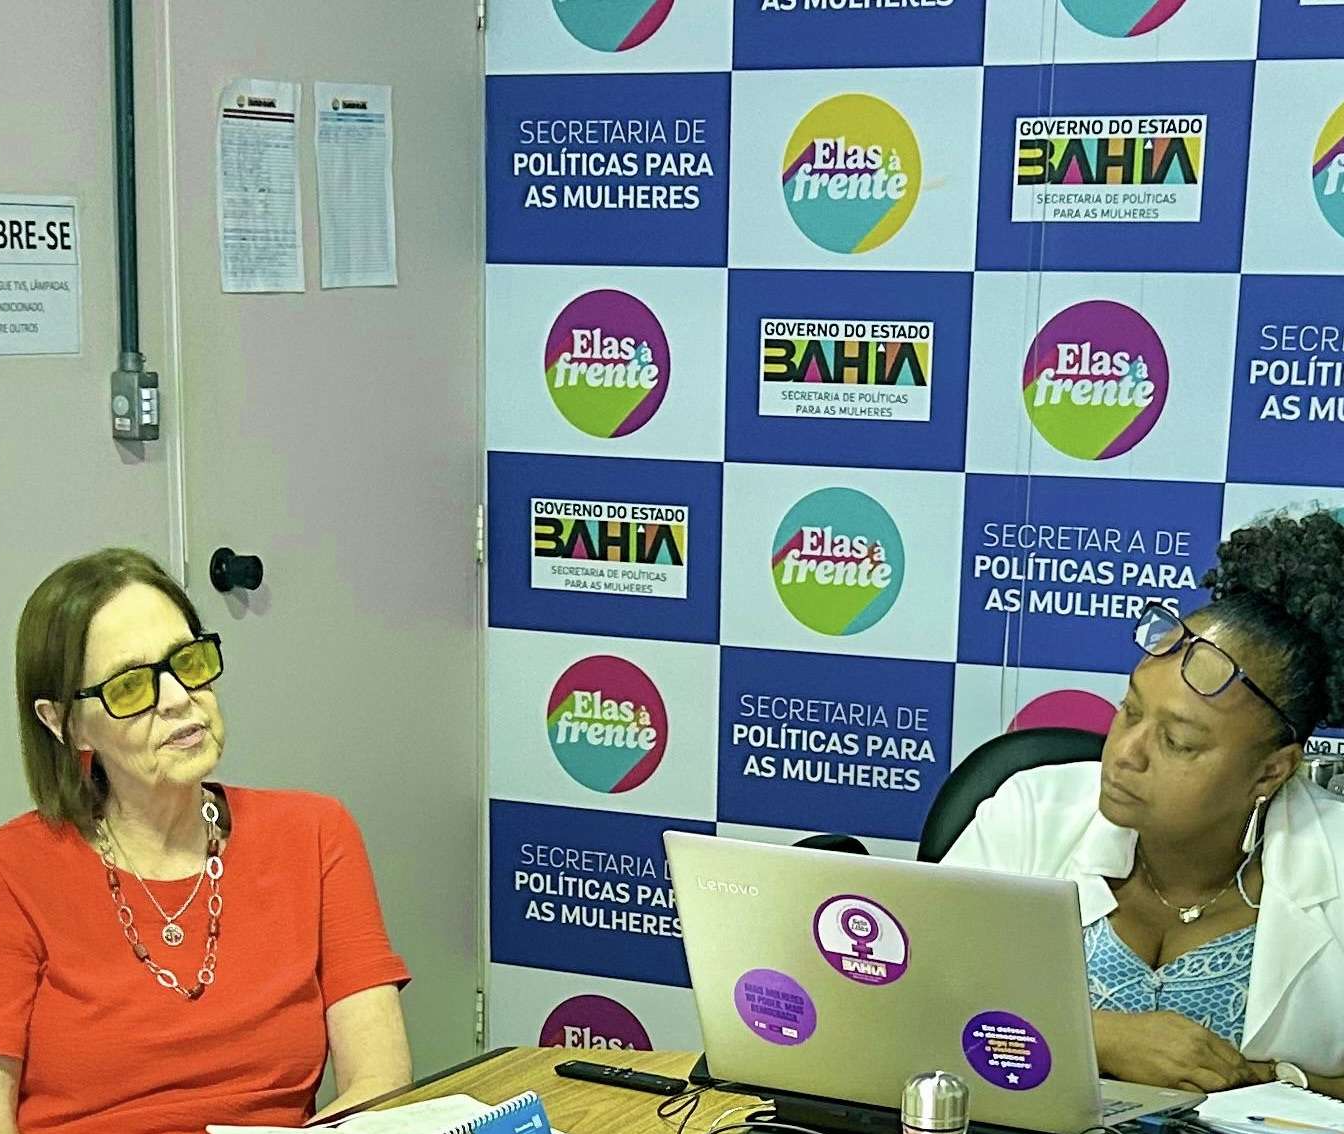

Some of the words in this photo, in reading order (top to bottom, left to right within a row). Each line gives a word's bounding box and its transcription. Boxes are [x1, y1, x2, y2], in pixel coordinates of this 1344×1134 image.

[521, 119, 667, 145] SECRETARIA
[675, 119, 706, 144] DE
[1020, 120, 1103, 135] GOVERNO
[1109, 120, 1132, 134] DO
[1138, 119, 1202, 134] ESTADO
[514, 148, 638, 176] POLÍTICAS
[646, 153, 713, 176] PARA
[812, 135, 883, 169] Elas
[888, 146, 902, 171] à
[1017, 138, 1198, 185] BAHIA
[525, 185, 557, 208] AS
[564, 186, 699, 209] MULHERES
[792, 166, 907, 200] frente
[1037, 194, 1101, 204] SECRETARIA
[1106, 194, 1118, 204] DE
[1123, 192, 1176, 204] POLÍTICAS
[1054, 209, 1081, 218] PARA
[1084, 209, 1097, 218] AS
[1101, 208, 1159, 219] MULHERES
[572, 327, 635, 360] Elas
[638, 339, 651, 361] à
[765, 321, 840, 338] GOVERNO
[844, 323, 866, 339] DO
[871, 325, 929, 339] ESTADO
[554, 353, 658, 388] frente
[763, 339, 928, 386] BAHIA
[1055, 341, 1128, 375] Elas
[1134, 351, 1147, 378] à
[782, 391, 839, 401] SECRETARIA
[843, 393, 855, 402] DE
[859, 392, 908, 404] POLÍTICAS
[1033, 369, 1154, 407] frente
[796, 405, 820, 414] PARA
[824, 406, 836, 415] AS
[839, 407, 892, 417] MULHERES
[1260, 395, 1300, 420] AS
[535, 502, 602, 517] GOVERNO
[607, 506, 627, 519] DO
[632, 507, 684, 522] ESTADO
[534, 518, 684, 566] BAHIA
[798, 524, 868, 557] Elas
[874, 537, 887, 562] à
[1156, 530, 1191, 556] DE
[551, 566, 605, 578] SECRETARIA
[607, 569, 618, 578] DE
[622, 570, 667, 582] POLÍTICAS
[565, 579, 588, 588] PARA
[590, 582, 601, 590] AS
[604, 582, 653, 593] MULHERES
[782, 551, 892, 588] frente
[974, 553, 1114, 585] POLÍTICAS
[1122, 563, 1196, 589] PARA
[985, 589, 1020, 612] AS
[1029, 590, 1179, 619] MULHERS
[572, 689, 638, 719] Elas
[640, 702, 652, 727] à
[741, 695, 888, 727] SECRETARIA
[897, 707, 928, 731] DE
[556, 714, 657, 749] frente
[734, 723, 859, 755] POLÍTICAS
[867, 736, 935, 762] PARA
[744, 755, 776, 777] AS
[783, 758, 920, 791] MULHERES
[521, 844, 656, 879] SECRETARIA
[515, 870, 630, 904] POLÍTICAS
[697, 876, 759, 897] Lenovo
[525, 900, 556, 921] AS
[561, 904, 682, 938] MULHERES
[563, 1025, 622, 1050] Elas
